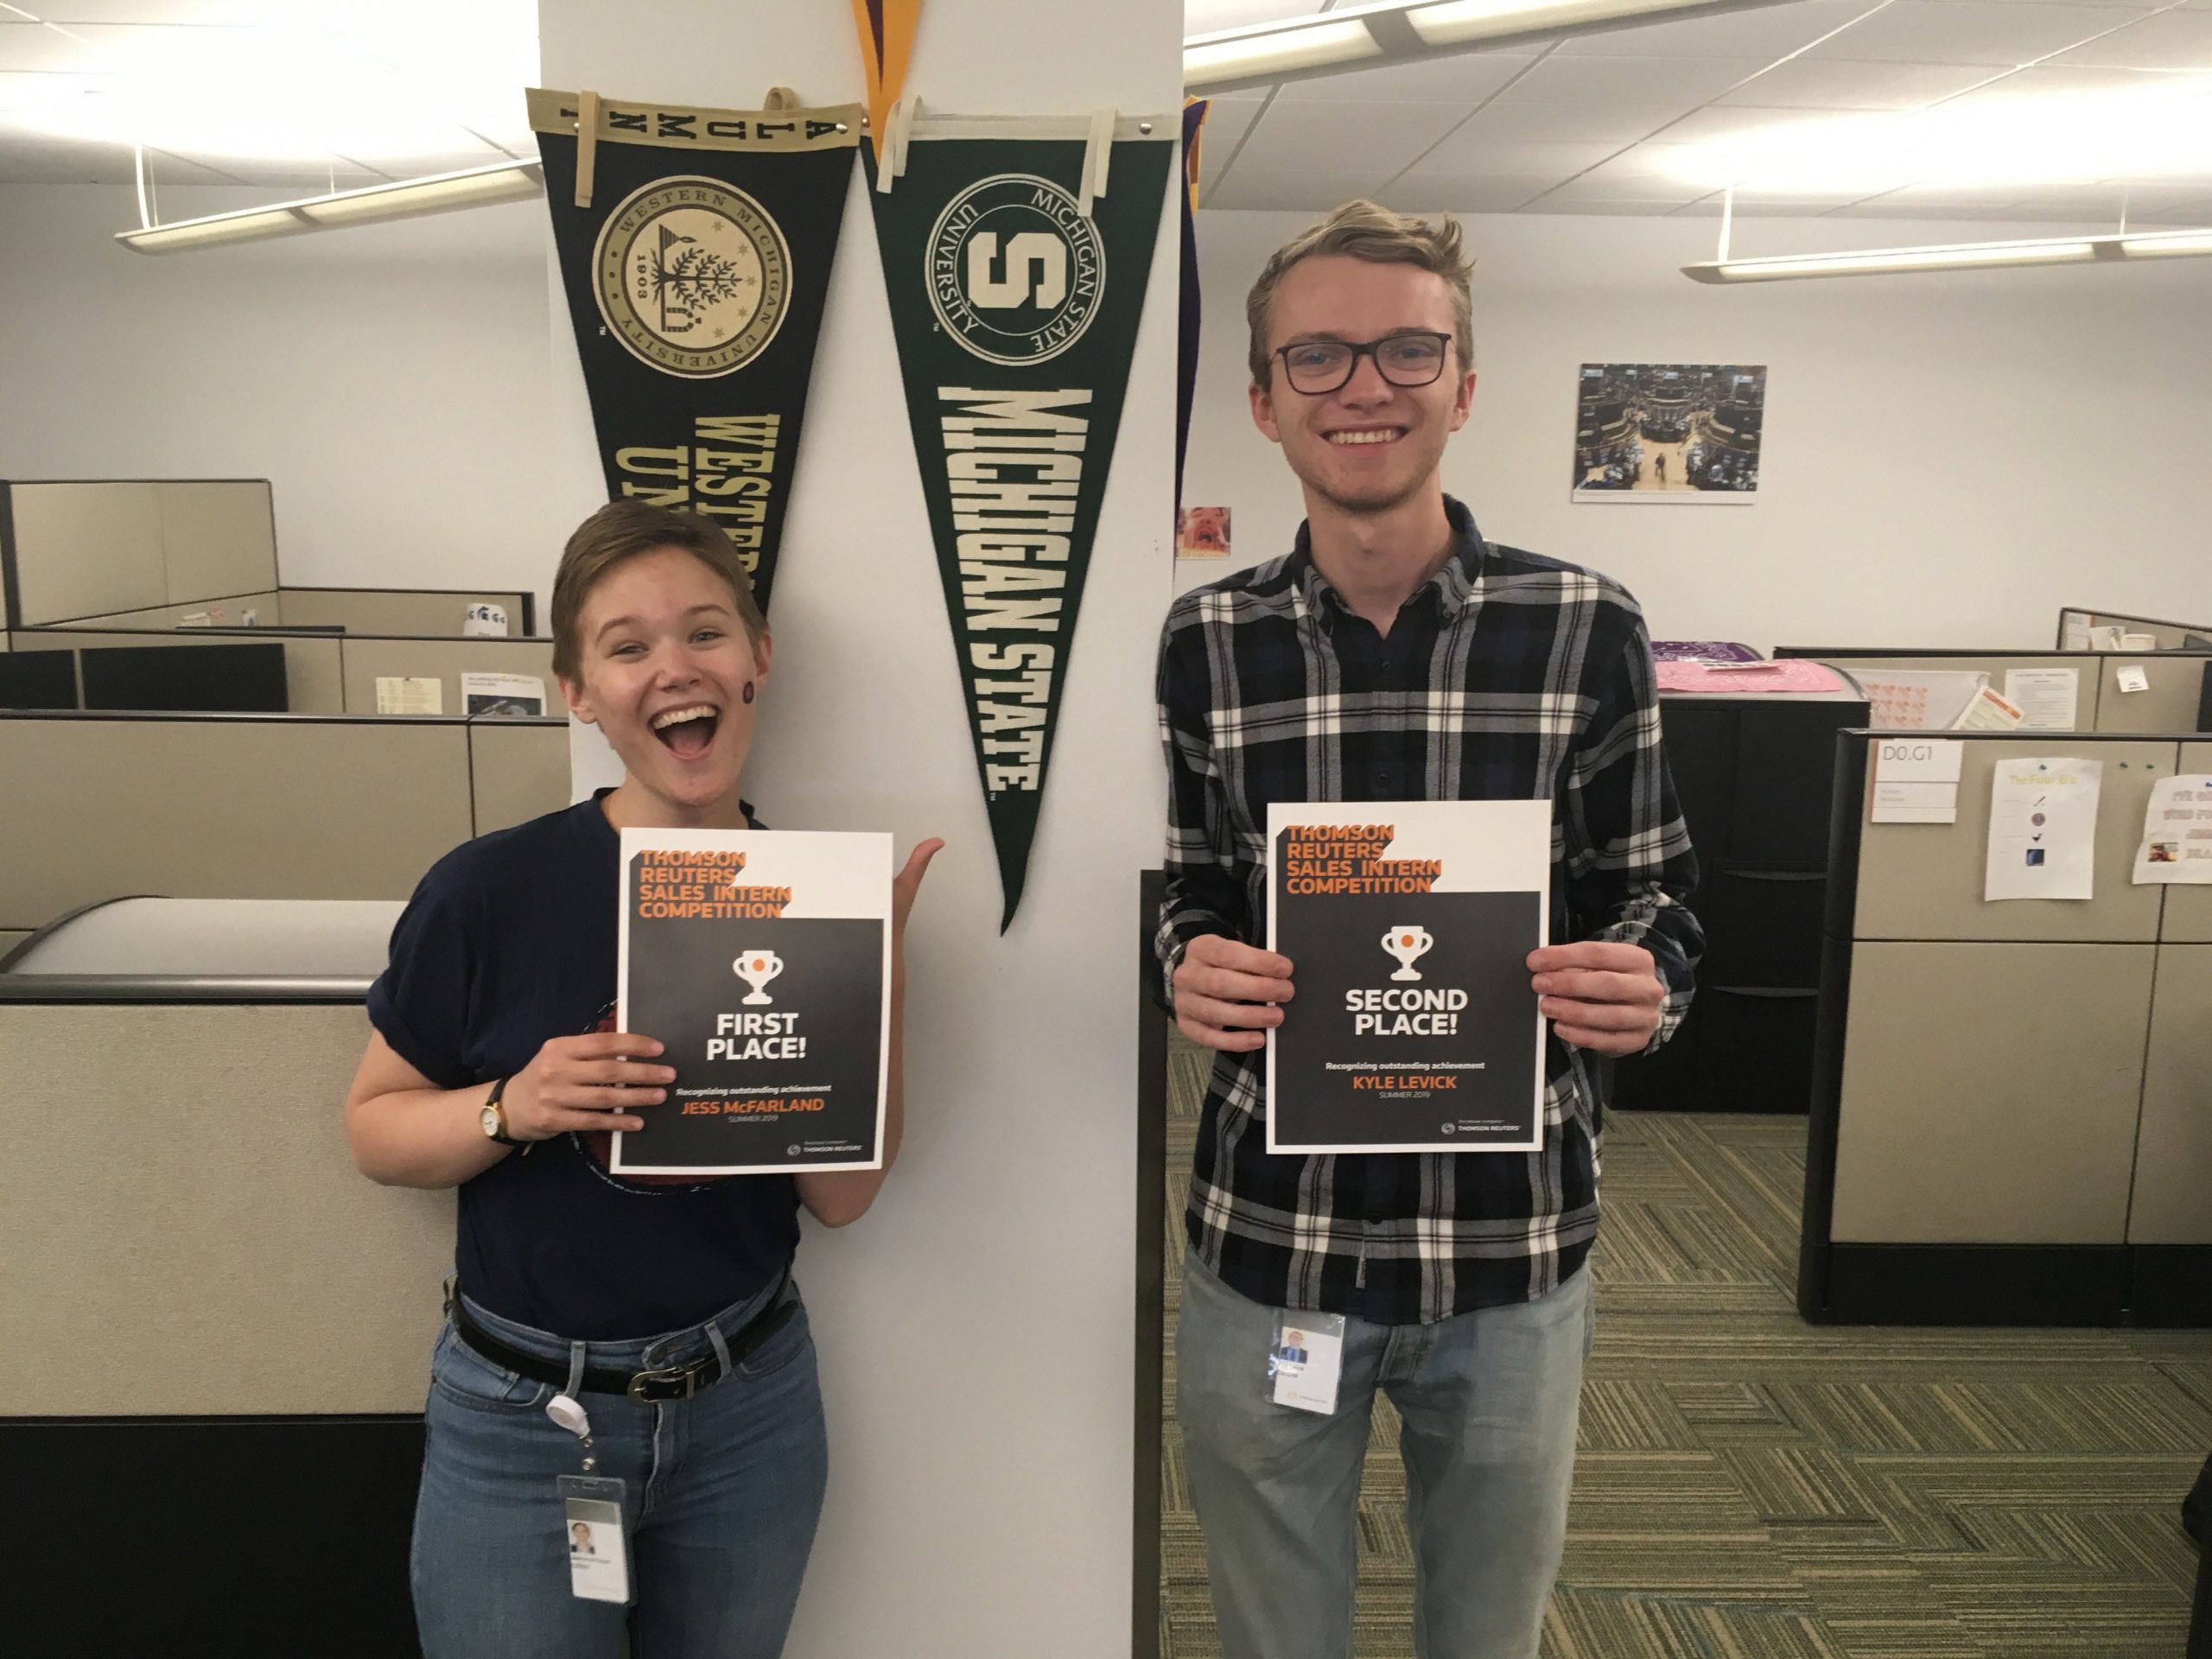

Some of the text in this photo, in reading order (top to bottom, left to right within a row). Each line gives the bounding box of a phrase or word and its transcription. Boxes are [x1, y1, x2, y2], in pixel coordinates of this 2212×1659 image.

[620, 189, 726, 234] WESTERN
[636, 254, 648, 299] 1903
[736, 207, 780, 325] MICHIGAN
[936, 203, 980, 334] UNIVERSITY
[967, 232, 1067, 309] S
[1030, 188, 1096, 353] MICHIGAN STATE
[621, 317, 758, 368] UNIVERSITY
[694, 413, 781, 591] WESTE
[937, 386, 1093, 791] MICHIGAN STATE
[1287, 824, 1395, 842] THOMSON
[639, 849, 747, 867] THOMSON
[1287, 842, 1384, 859] REUTERS
[640, 867, 736, 884] REUTERS
[1287, 859, 1442, 876] SALES INTERN
[639, 884, 792, 901] SALES INTERN
[1286, 877, 1432, 894] COMPETITION
[639, 902, 782, 918] COMPETITION
[1344, 988, 1469, 1012] SECOND
[716, 1013, 799, 1036] FIRST
[1355, 1014, 1458, 1036] PLACE!
[706, 1037, 807, 1061] PLACE!
[1325, 1062, 1377, 1071] Recognizing
[1379, 1062, 1430, 1071] outstanding
[676, 1084, 832, 1097] Recognizing outstanding achievement
[1352, 1076, 1458, 1090] KYLE LEVICK
[681, 1097, 825, 1116] JESS McFARLAND
